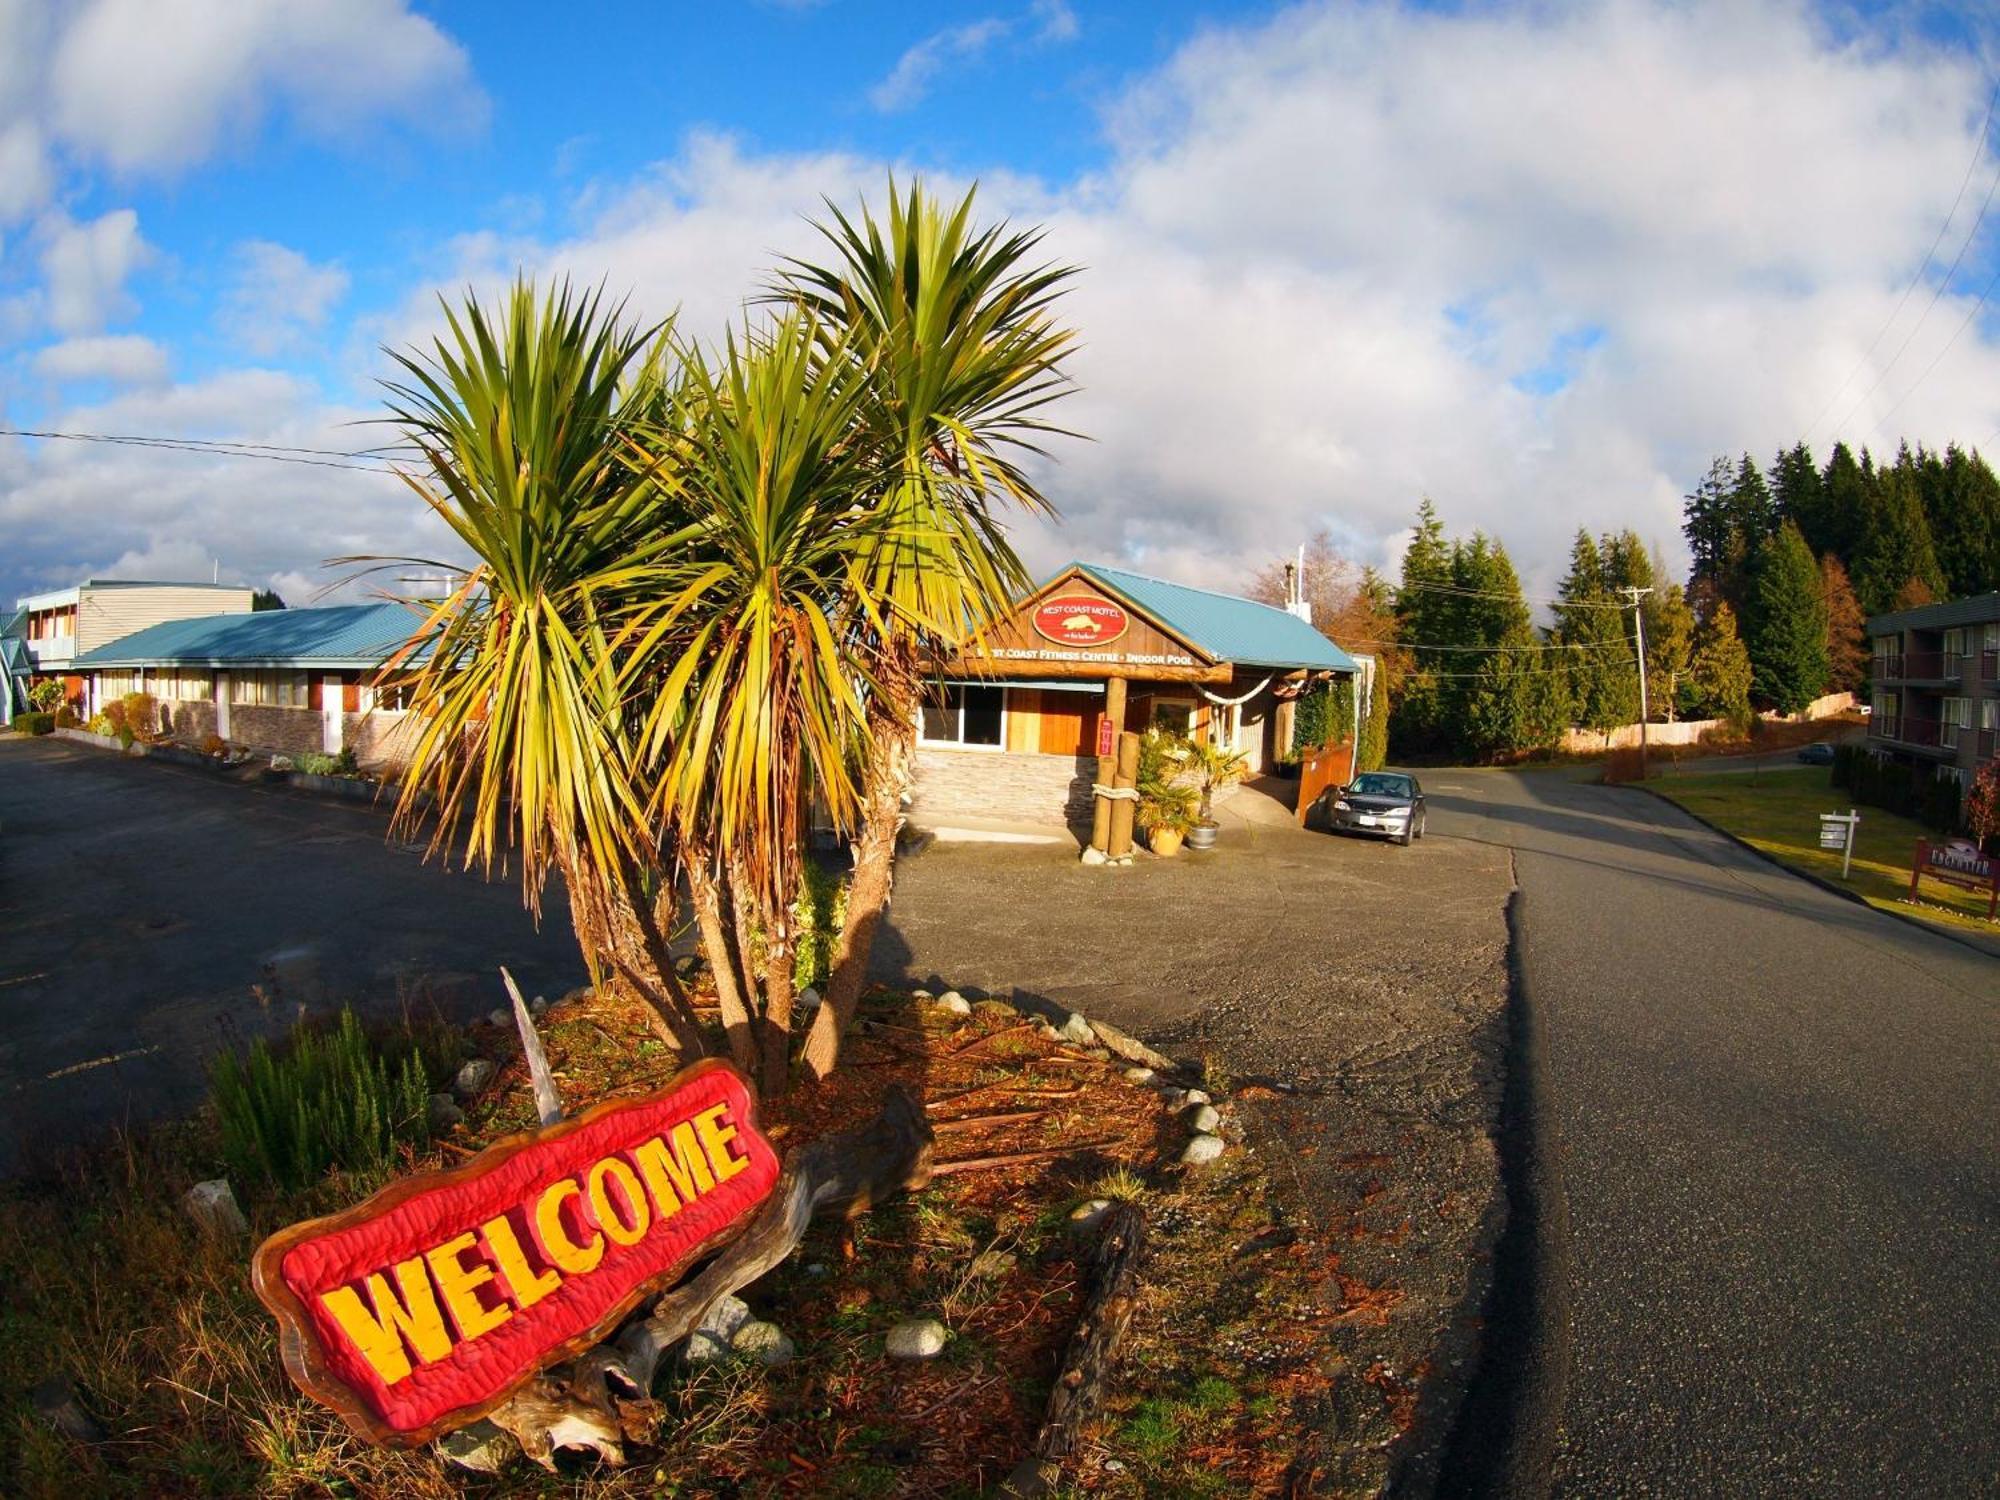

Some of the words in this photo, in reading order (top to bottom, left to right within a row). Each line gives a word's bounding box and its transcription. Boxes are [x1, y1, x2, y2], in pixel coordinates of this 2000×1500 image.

[1042, 606, 1062, 615] WEST
[1063, 606, 1091, 615] COAST
[1091, 606, 1120, 618] MOTEL
[977, 648, 1004, 658] WST
[1006, 648, 1038, 659] COAST
[1040, 650, 1079, 660] FITNESS
[1082, 652, 1119, 662] CENTRE
[1126, 653, 1165, 664] INDOOR
[1167, 654, 1193, 665] POOL
[321, 1102, 750, 1386] WELCOME
